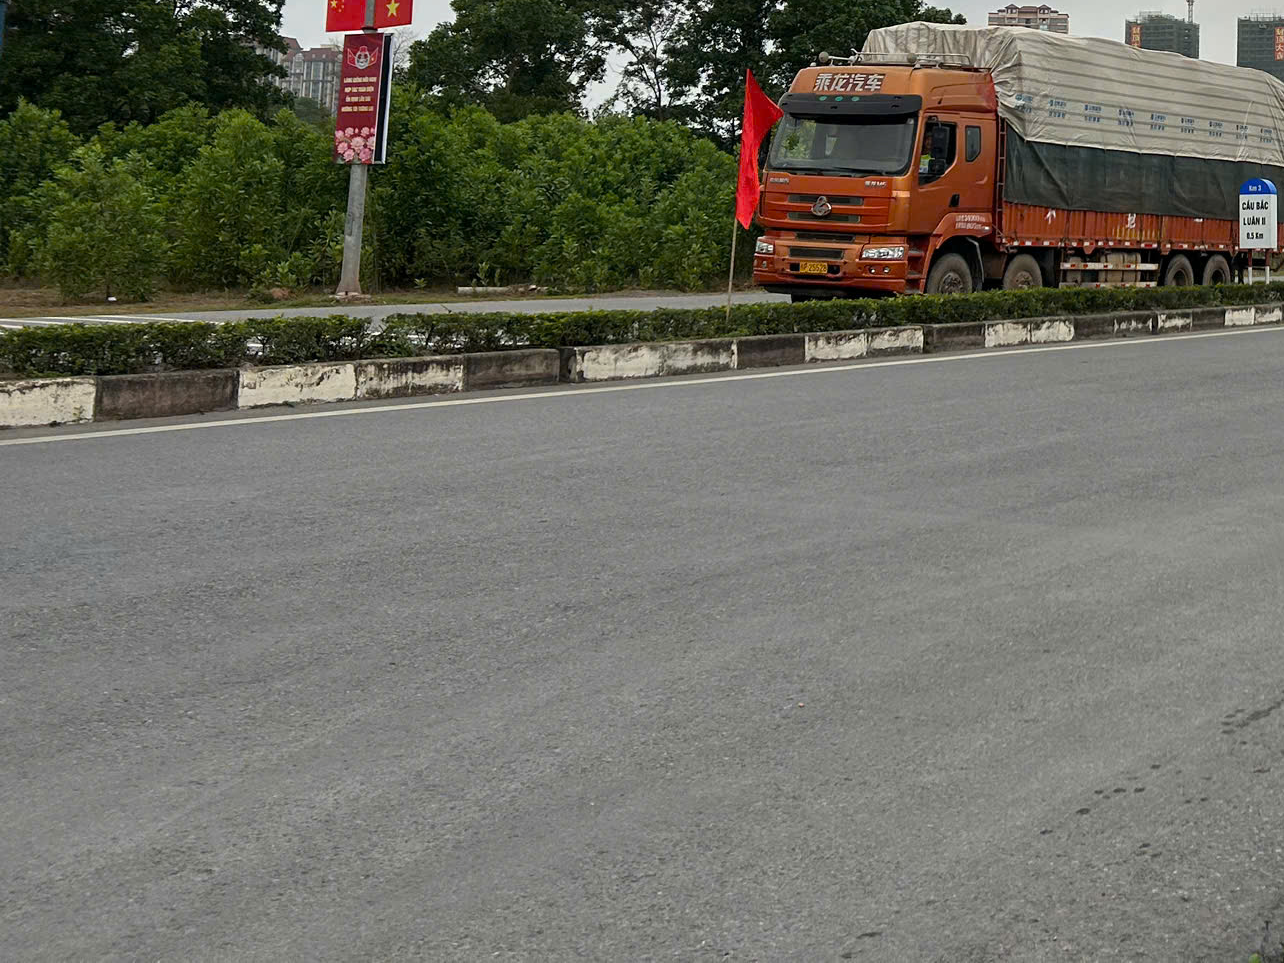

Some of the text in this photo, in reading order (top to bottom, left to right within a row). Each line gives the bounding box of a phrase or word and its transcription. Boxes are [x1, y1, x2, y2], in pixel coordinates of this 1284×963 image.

[813, 73, 885, 92] 乘龙汽车
[1243, 215, 1260, 225] LUÂN
